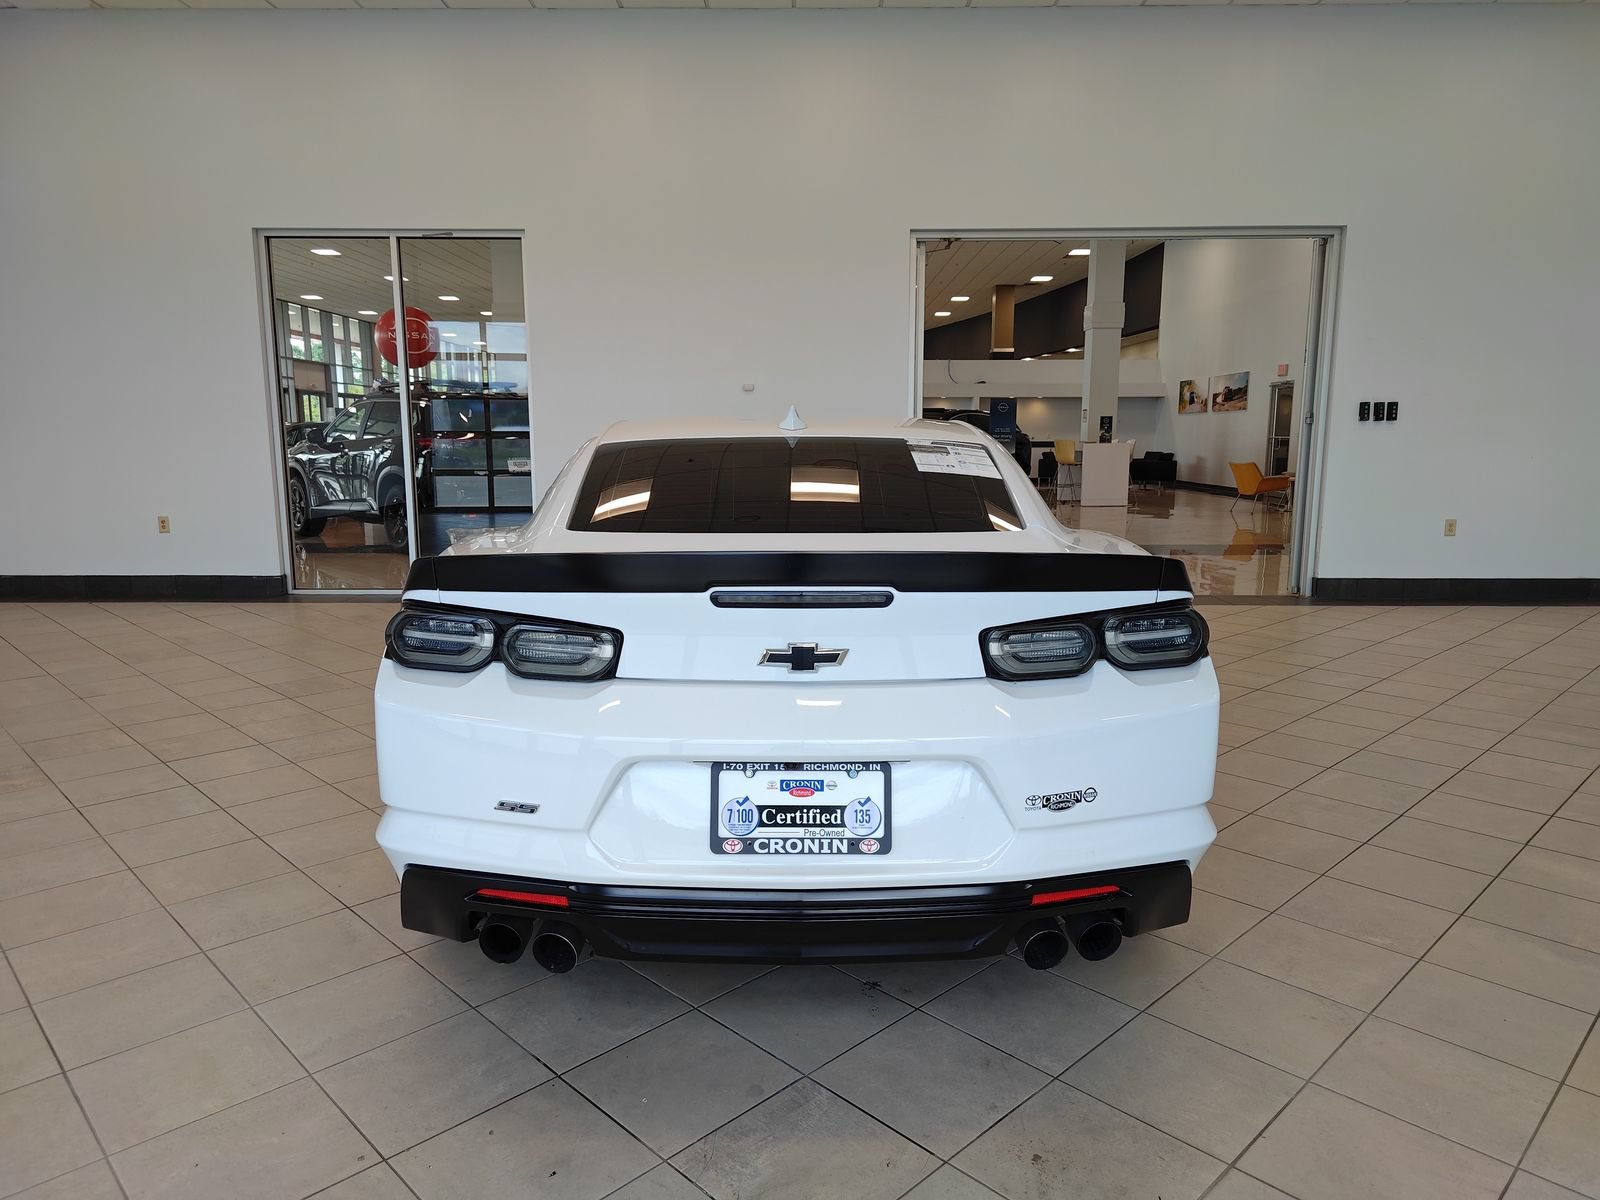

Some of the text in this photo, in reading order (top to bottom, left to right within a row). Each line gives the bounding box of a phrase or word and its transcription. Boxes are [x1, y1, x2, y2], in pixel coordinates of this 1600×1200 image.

[388, 331, 436, 340] NSAN
[803, 763, 866, 771] RICHMOND,
[869, 763, 881, 771] IN
[782, 780, 822, 791] CRONIN
[1043, 790, 1082, 805] CRONIN
[761, 808, 842, 825] Certified
[854, 809, 871, 824] 135
[803, 828, 846, 837] Pre-Owned
[753, 838, 848, 854] CRONIN
